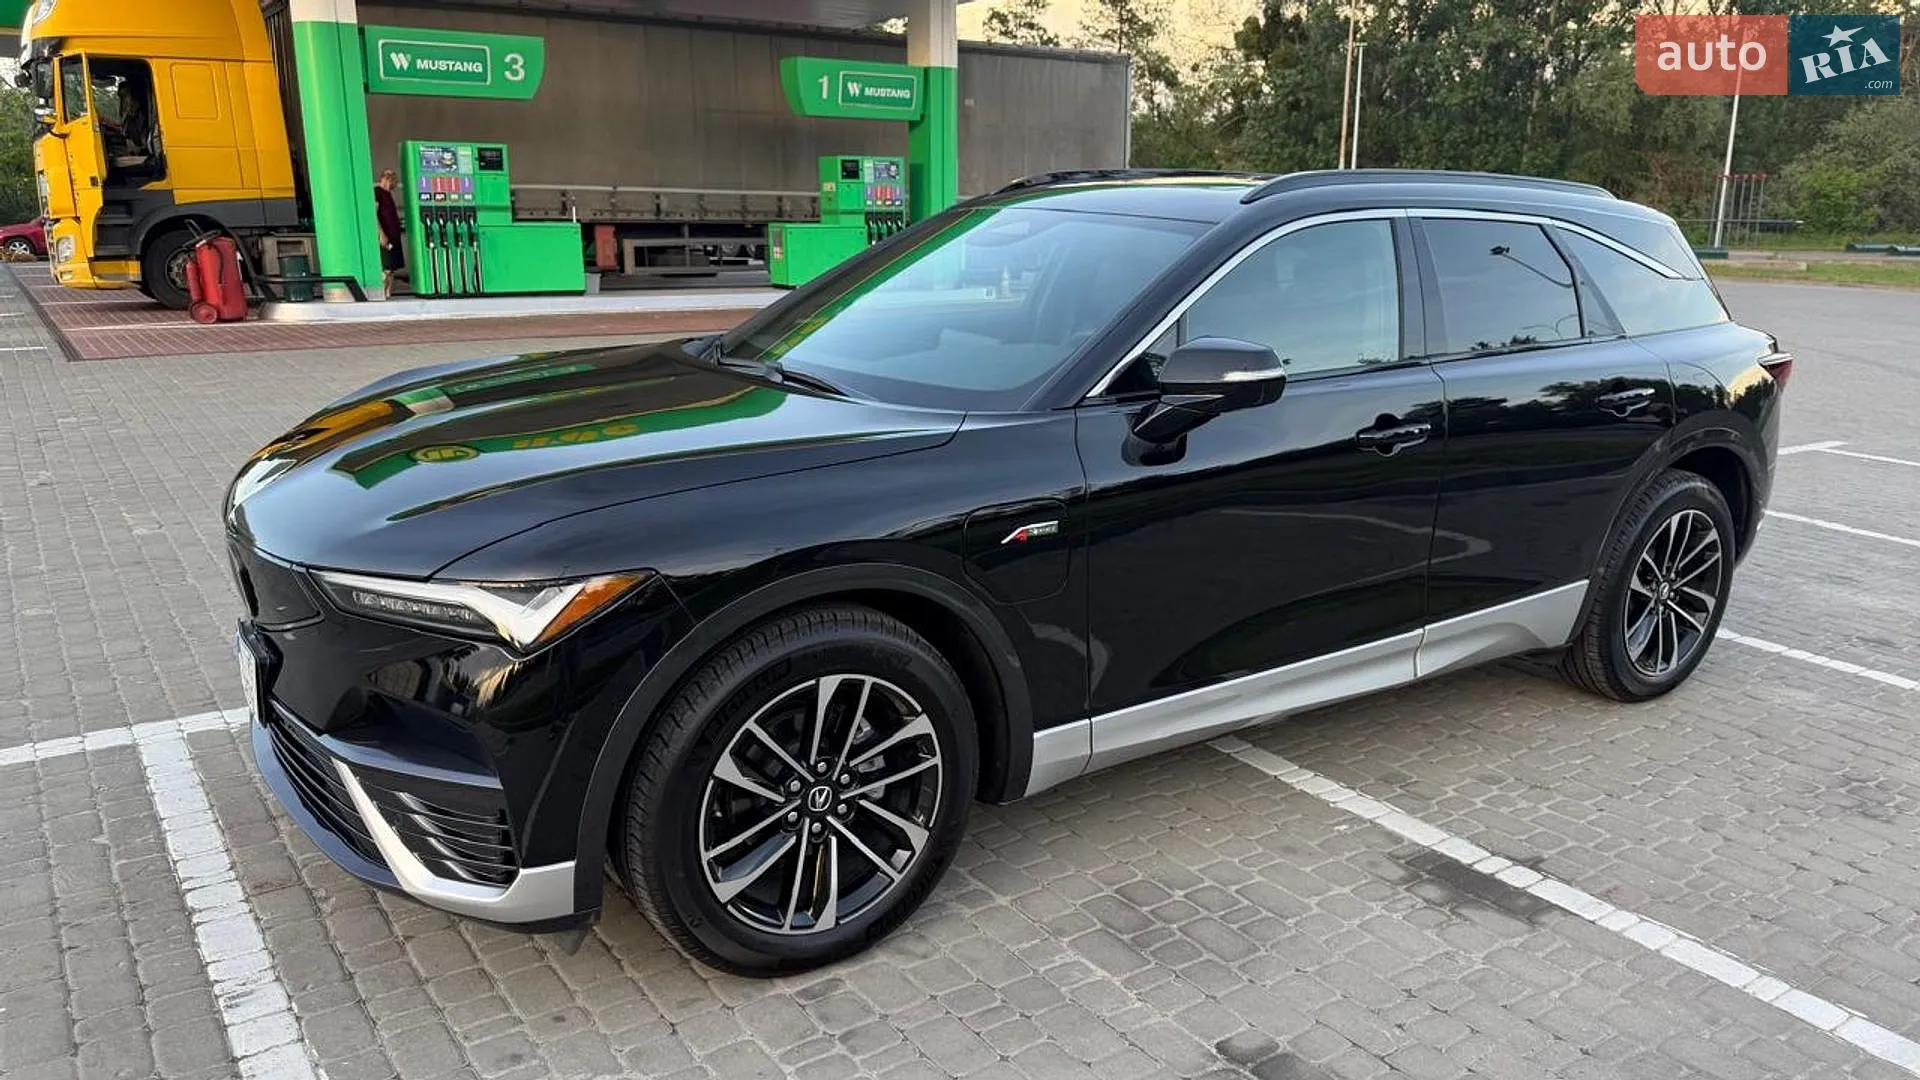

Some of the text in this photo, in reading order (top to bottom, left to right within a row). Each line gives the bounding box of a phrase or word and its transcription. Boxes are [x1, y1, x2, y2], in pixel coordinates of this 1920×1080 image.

[416, 58, 483, 73] MUSTANG
[503, 53, 525, 81] 3
[818, 75, 829, 99] 1
[863, 86, 911, 99] MUSTANG
